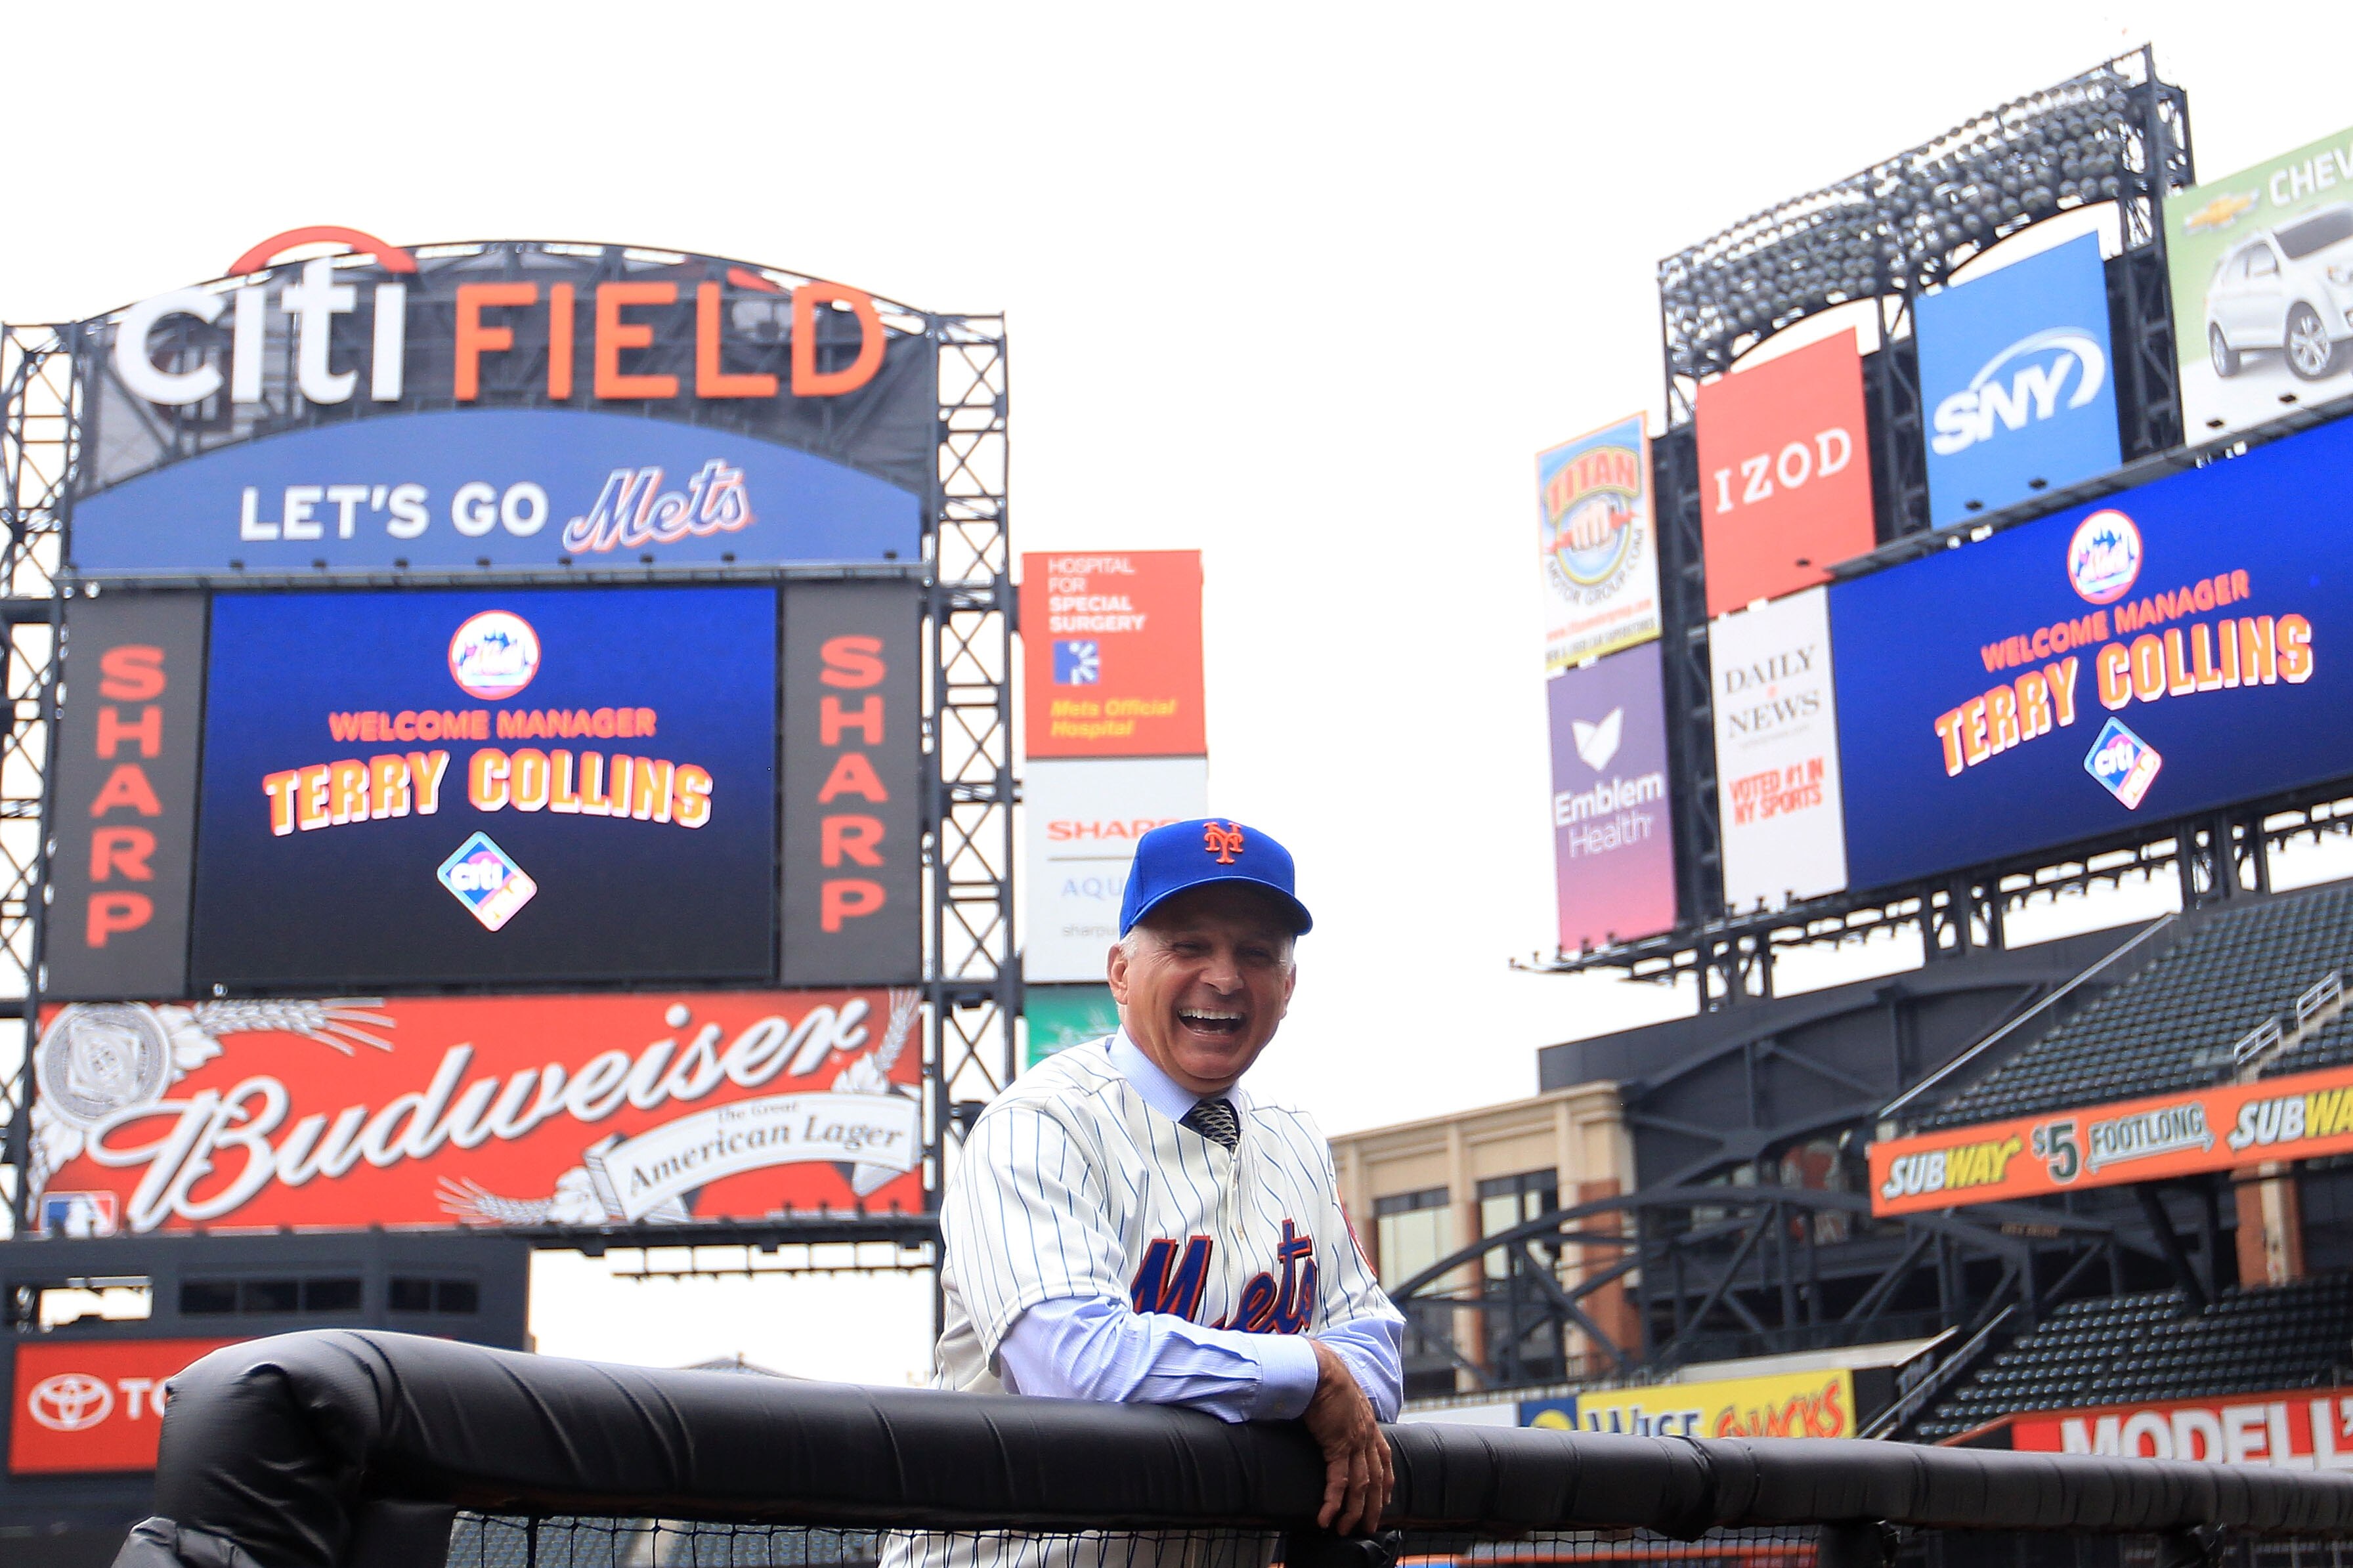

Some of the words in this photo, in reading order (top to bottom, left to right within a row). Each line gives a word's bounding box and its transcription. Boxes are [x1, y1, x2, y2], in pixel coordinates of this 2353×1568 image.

[114, 257, 407, 405] citi
[453, 280, 886, 400] FIELD
[1931, 353, 2076, 455] SNY
[1547, 450, 1636, 516] TITAN
[1715, 428, 1851, 515] IZOD
[241, 482, 430, 541] LET'S
[450, 481, 550, 538] GO
[561, 457, 756, 553] Mets
[1048, 558, 1136, 575] HOSPITAL
[1048, 577, 1087, 593] FOR
[1048, 595, 1133, 613] SPECIAL
[1048, 615, 1146, 633] SURGERY
[1981, 610, 2109, 673] WELCOME
[2113, 568, 2251, 635] MANAGER
[1725, 643, 1817, 693] DAILY
[1934, 656, 2079, 778] TERRY
[2096, 613, 2314, 711] COLLINS
[329, 710, 490, 742] WELCOME
[496, 708, 657, 739] MANAGER
[1050, 701, 1100, 717] Mets
[1104, 699, 1177, 716] Official
[1051, 721, 1135, 739] Hospital
[1729, 689, 1821, 738] NEWS
[87, 644, 167, 948] SHARP
[263, 750, 450, 837] TERRY
[468, 748, 713, 829] COLLINS
[818, 635, 888, 933] SHARP
[1555, 772, 1664, 828] Emblem
[1729, 769, 1781, 803] VOTED
[1785, 763, 1803, 786] #1
[1807, 756, 1824, 782] IN
[1734, 801, 1756, 826] NY
[1760, 783, 1823, 820] SPORTS
[1568, 813, 1654, 857] Health
[85, 998, 871, 1233] Budweiser
[630, 1122, 791, 1197] American
[802, 1114, 904, 1151] Lager
[1882, 1134, 2023, 1200] SUBWAY
[2032, 1118, 2081, 1184] $5
[2088, 1103, 2205, 1156] FOOTLONG
[1131, 1218, 1317, 1334] Mets
